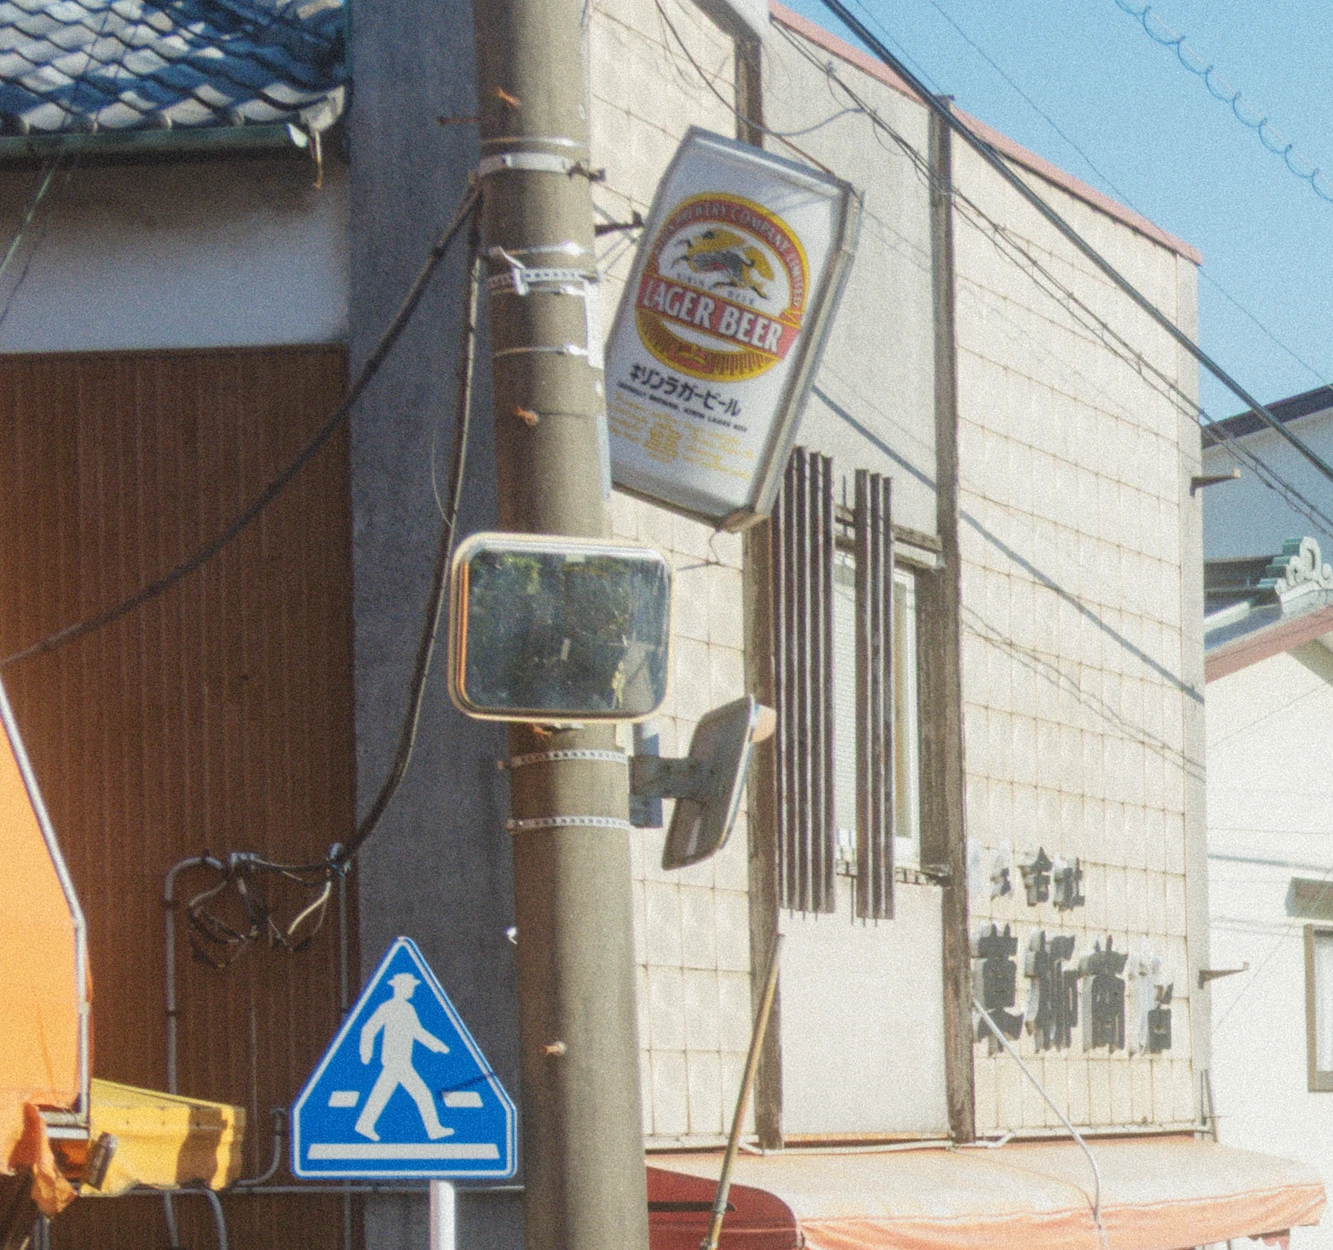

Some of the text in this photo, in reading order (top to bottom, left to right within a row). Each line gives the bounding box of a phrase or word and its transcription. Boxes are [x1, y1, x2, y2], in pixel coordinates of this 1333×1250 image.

[642, 280, 783, 353] LAGER BEER
[629, 364, 741, 418] キリンラガービール
